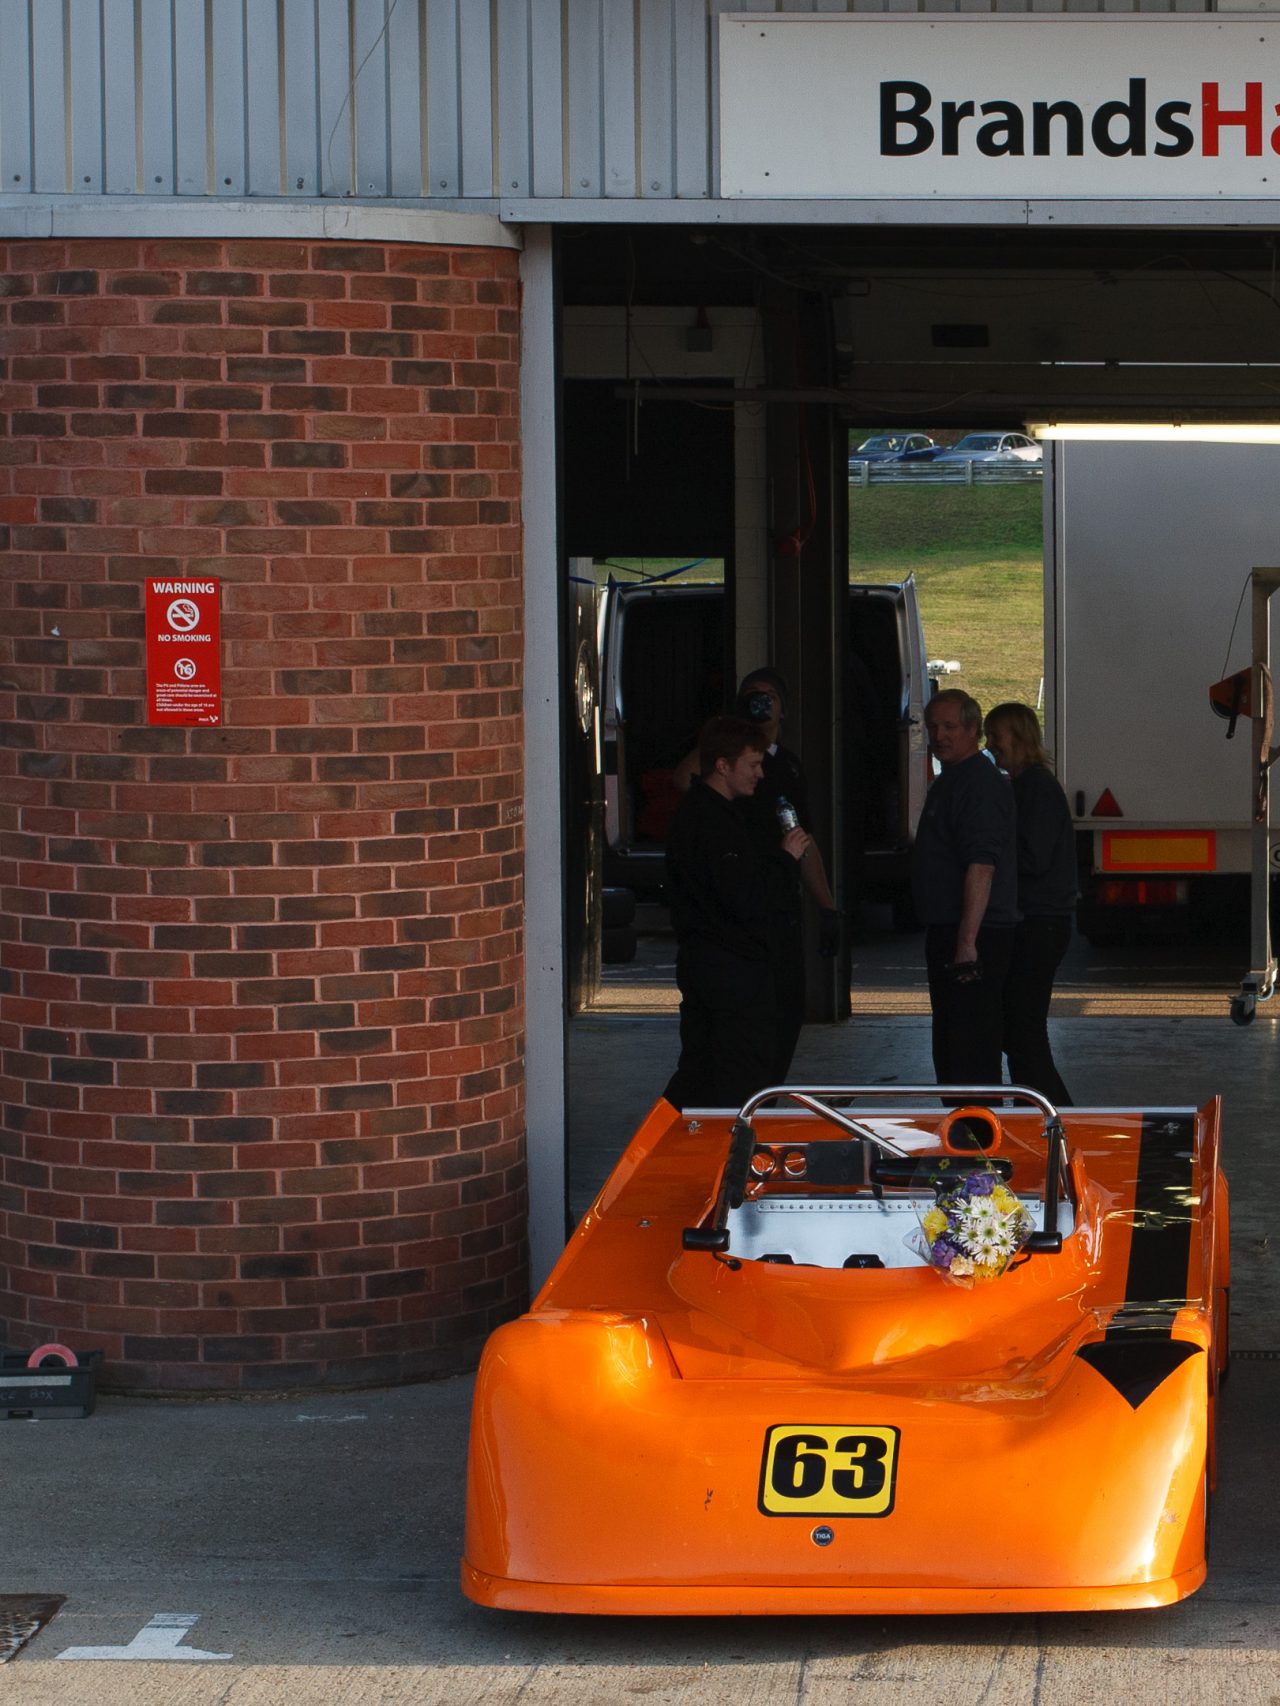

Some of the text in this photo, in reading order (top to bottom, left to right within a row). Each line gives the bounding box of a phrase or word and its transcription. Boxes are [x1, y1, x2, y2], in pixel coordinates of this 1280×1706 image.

[152, 582, 215, 594] WARNING
[157, 634, 211, 642] NO SMOKING
[177, 663, 193, 675] 16
[771, 1434, 888, 1500] 63
